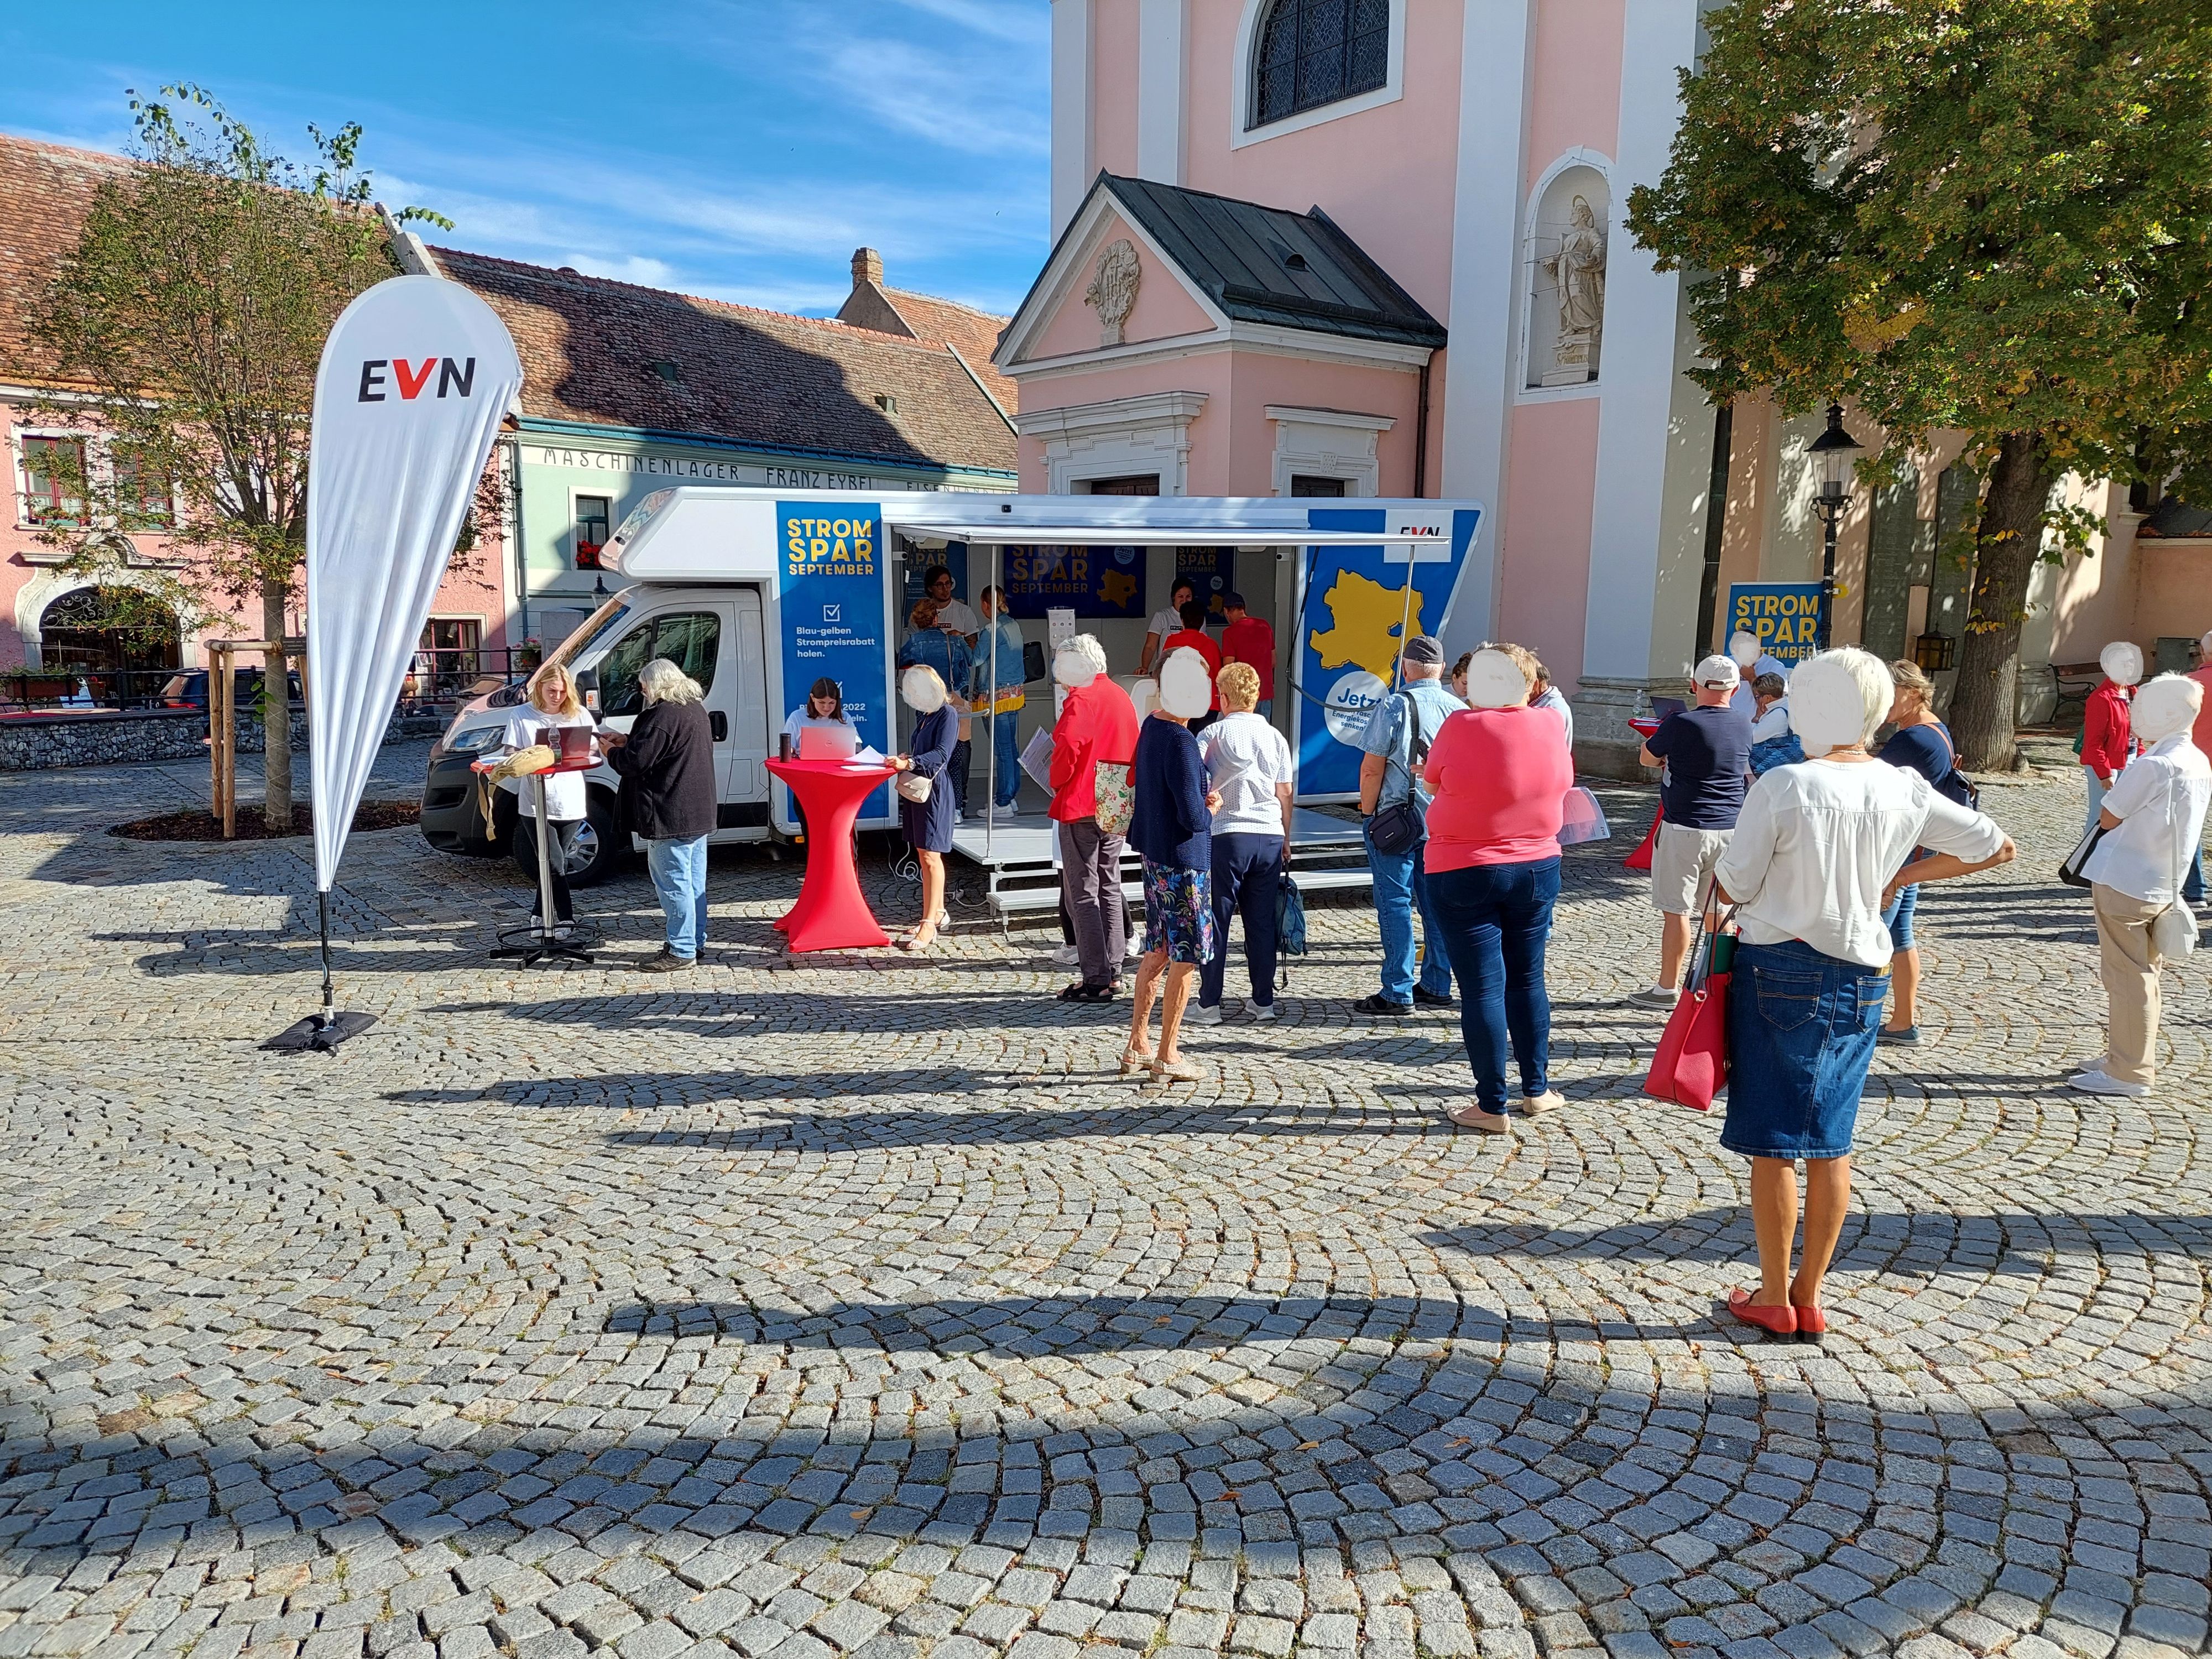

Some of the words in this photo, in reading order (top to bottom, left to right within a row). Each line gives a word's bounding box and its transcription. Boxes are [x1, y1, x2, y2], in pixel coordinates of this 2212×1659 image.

[358, 357, 476, 402] EVN
[544, 447, 738, 479] MASCHINENLAGER
[766, 467, 821, 488] FRANZ
[787, 518, 872, 538] STROM
[1400, 526, 1440, 536] EVN
[789, 538, 873, 562] SPAR
[1178, 554, 1216, 566] SPAR
[789, 564, 874, 576] SEPTEMBER
[1013, 558, 1088, 581] SPAR
[1012, 583, 1088, 593] SEPTEMBER
[1736, 595, 1819, 617] STROM
[796, 627, 852, 636] Blau-gelben
[796, 638, 875, 648] Strompreisrabatt
[1760, 646, 1815, 659] TEMBER
[1338, 688, 1381, 707] Jetz
[1332, 711, 1368, 725] Energiekos
